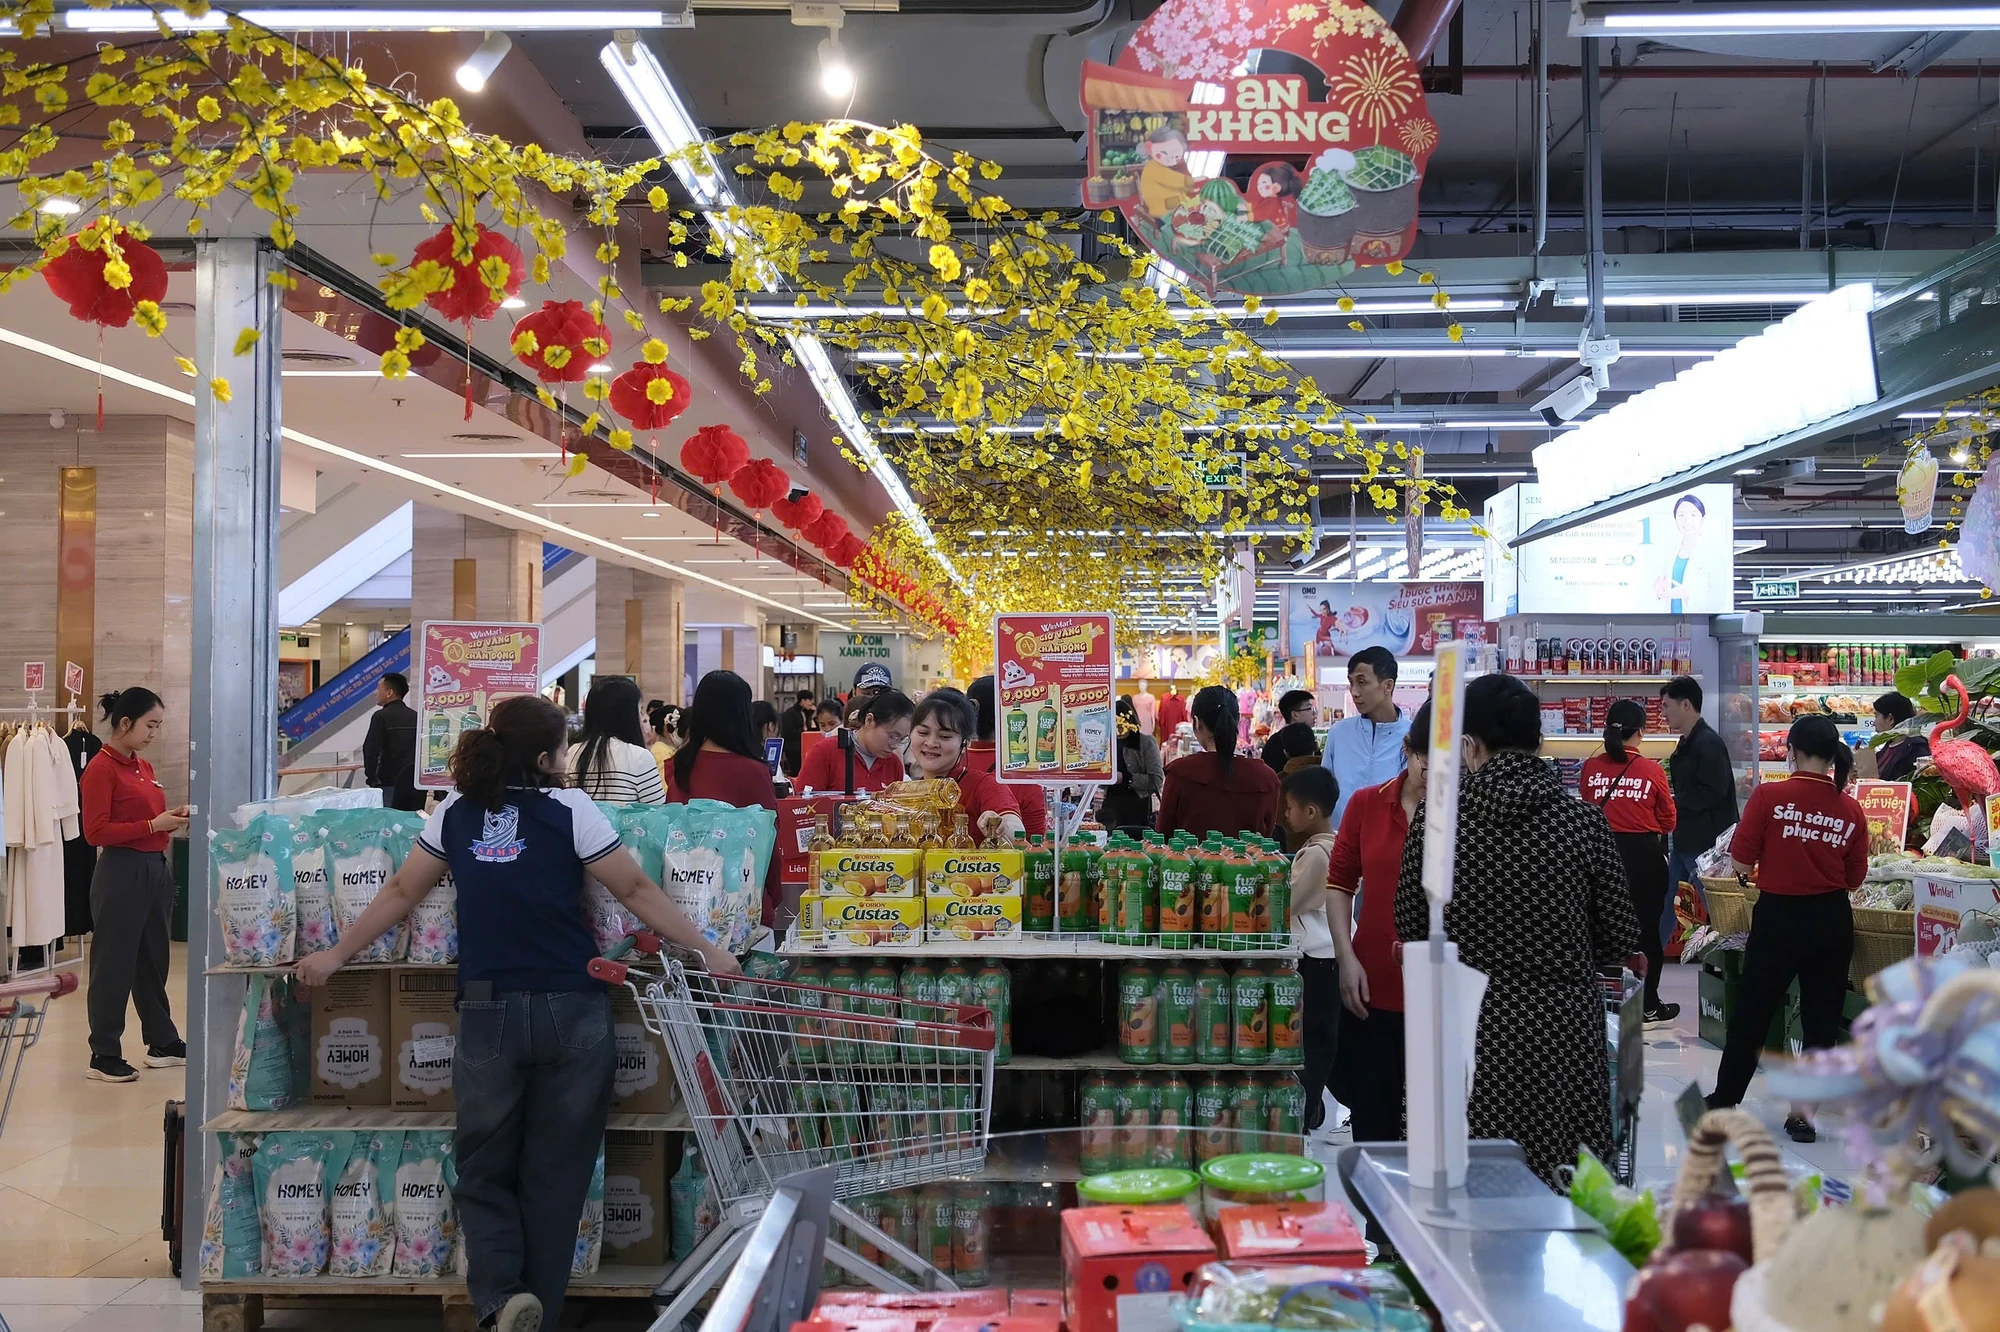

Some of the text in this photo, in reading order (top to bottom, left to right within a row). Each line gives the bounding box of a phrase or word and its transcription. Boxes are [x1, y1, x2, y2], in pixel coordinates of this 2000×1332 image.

[1040, 618, 1072, 632] WinMart
[470, 628, 502, 640] WinMart
[1464, 632, 1478, 640] OMO
[1010, 719, 1026, 728] fuze
[1040, 716, 1056, 724] fuze
[1084, 728, 1102, 736] HOMEY
[1588, 772, 1610, 786] Sẵn
[1773, 802, 1844, 832] Sẵn sàng
[1782, 822, 1820, 842] phục
[838, 858, 894, 872] Custas
[944, 859, 1001, 874] Custas
[342, 870, 387, 886] HOMEY
[671, 868, 714, 885] HOMEY
[1034, 870, 1050, 880] tea
[1162, 869, 1190, 882] fuze
[1162, 880, 1183, 890] tea
[1235, 884, 1254, 895] tea
[1928, 882, 1954, 900] WinMart
[842, 906, 900, 920] Custas
[946, 902, 1002, 916] Custas
[1236, 984, 1264, 998] fuze
[1273, 983, 1301, 998] fuze
[1236, 997, 1258, 1007] tea
[1274, 996, 1296, 1006] tea
[1700, 996, 1723, 1023] WinMart
[327, 1050, 369, 1062] HOMEY
[278, 1184, 322, 1199] HOMEY
[334, 1182, 370, 1198] HOMEY
[402, 1183, 444, 1198] HOMEY
